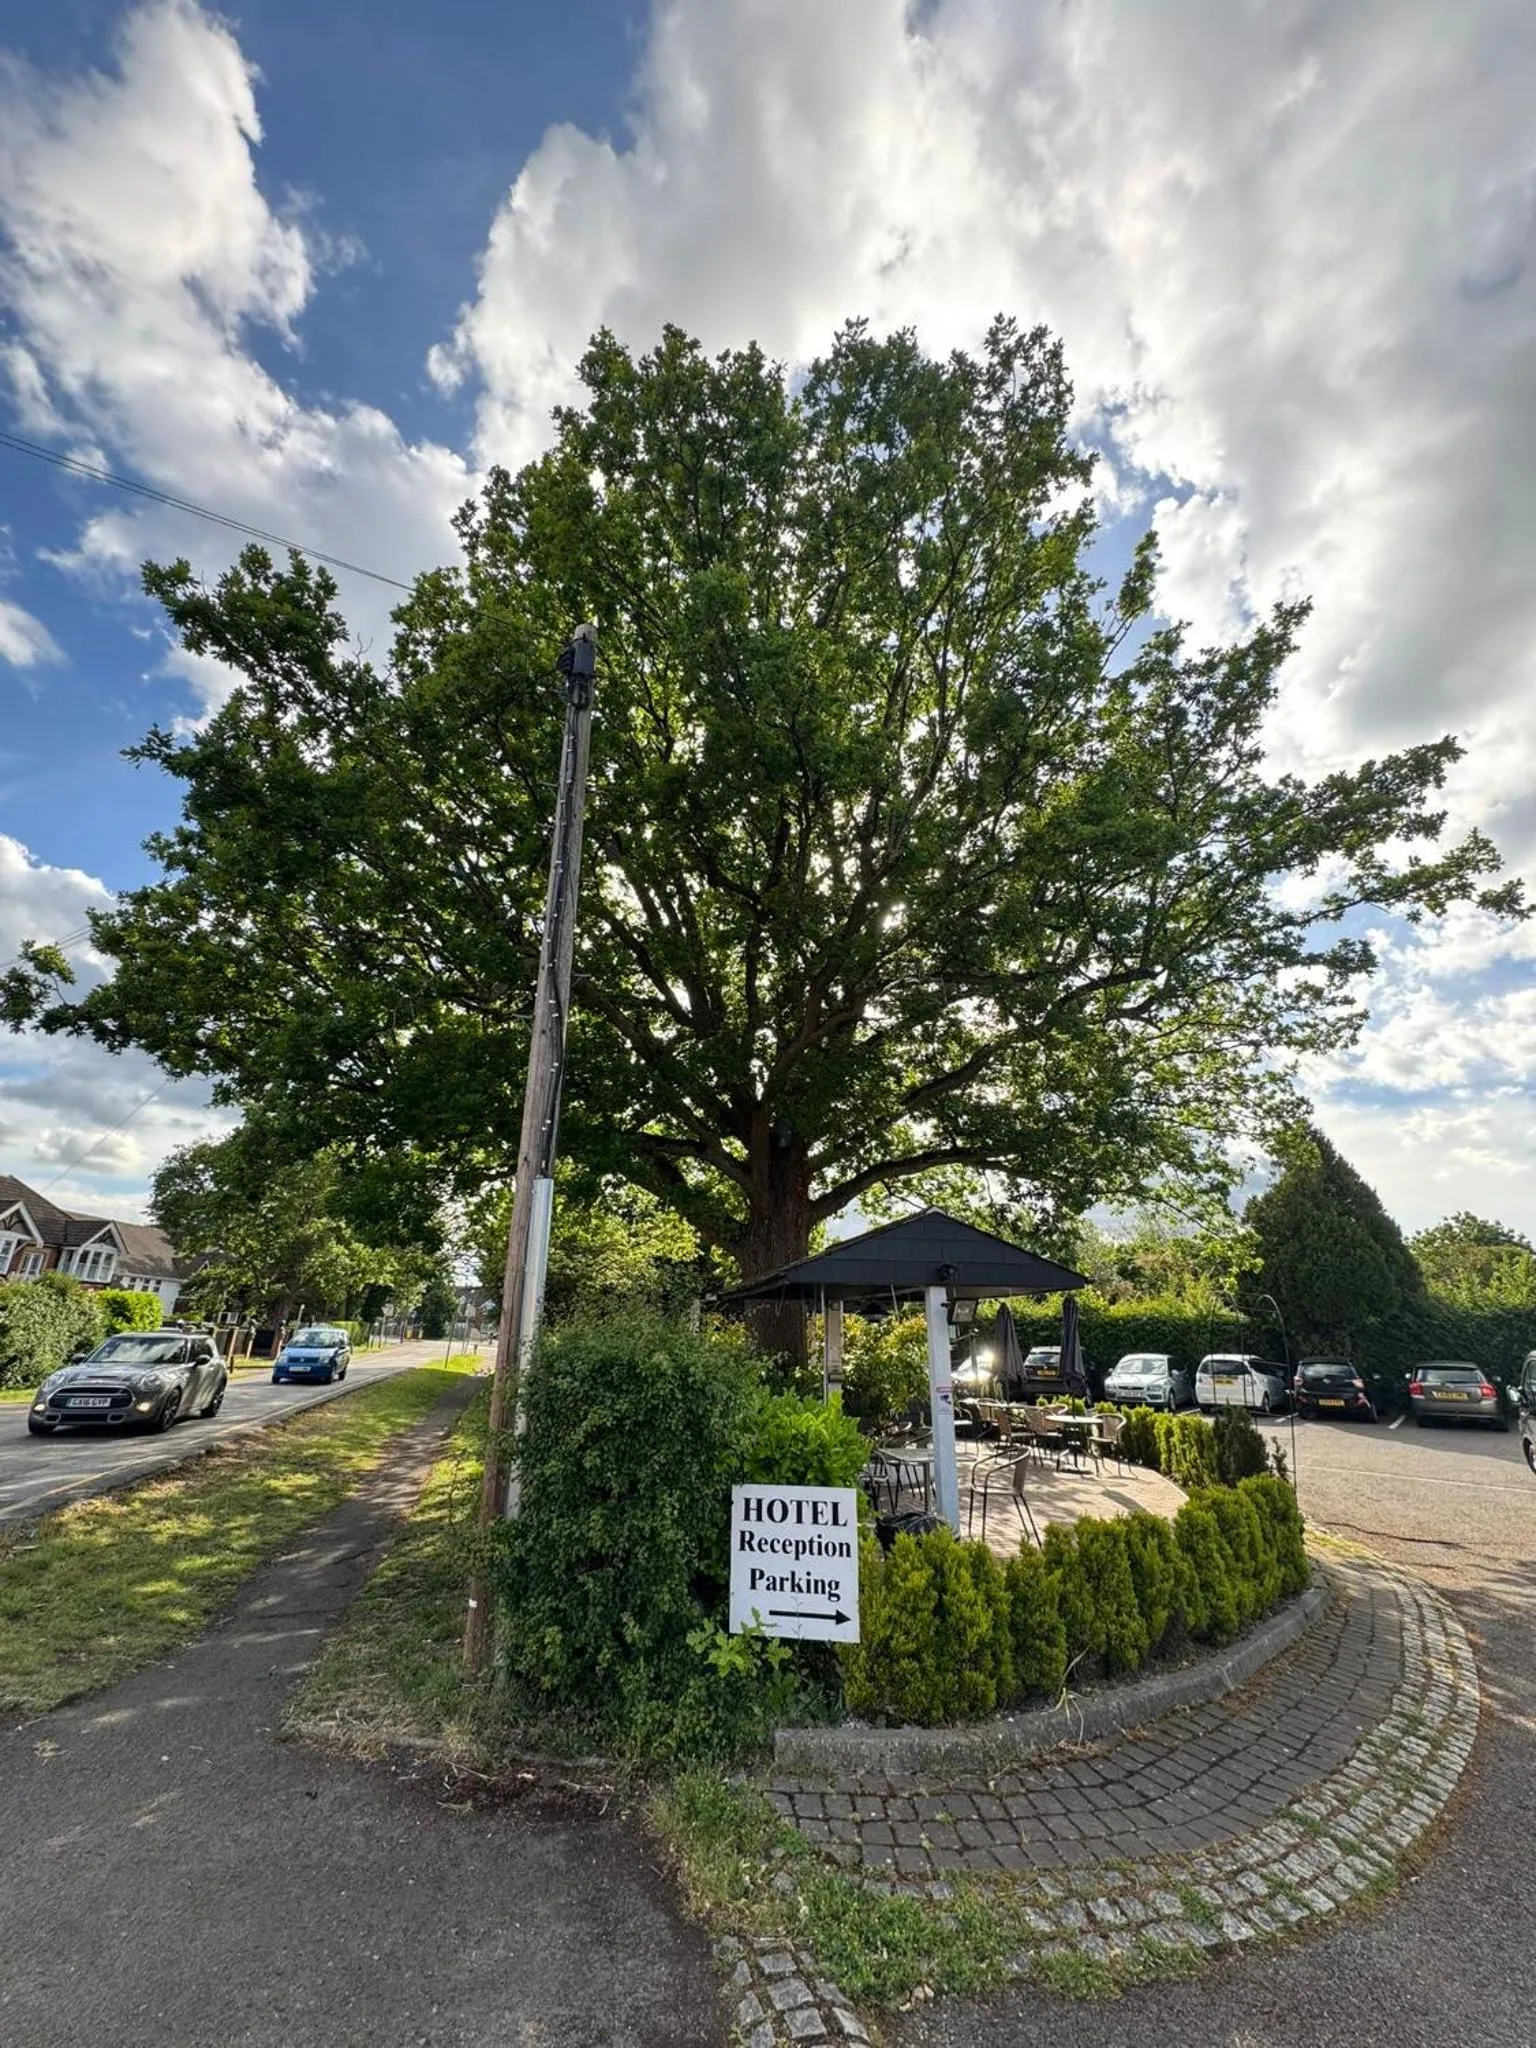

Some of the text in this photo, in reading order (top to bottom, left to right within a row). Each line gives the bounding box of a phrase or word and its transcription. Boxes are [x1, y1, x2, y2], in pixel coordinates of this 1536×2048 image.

[743, 1497, 848, 1527] HOTEL
[739, 1530, 851, 1561] Reception
[749, 1567, 841, 1602] Parking
